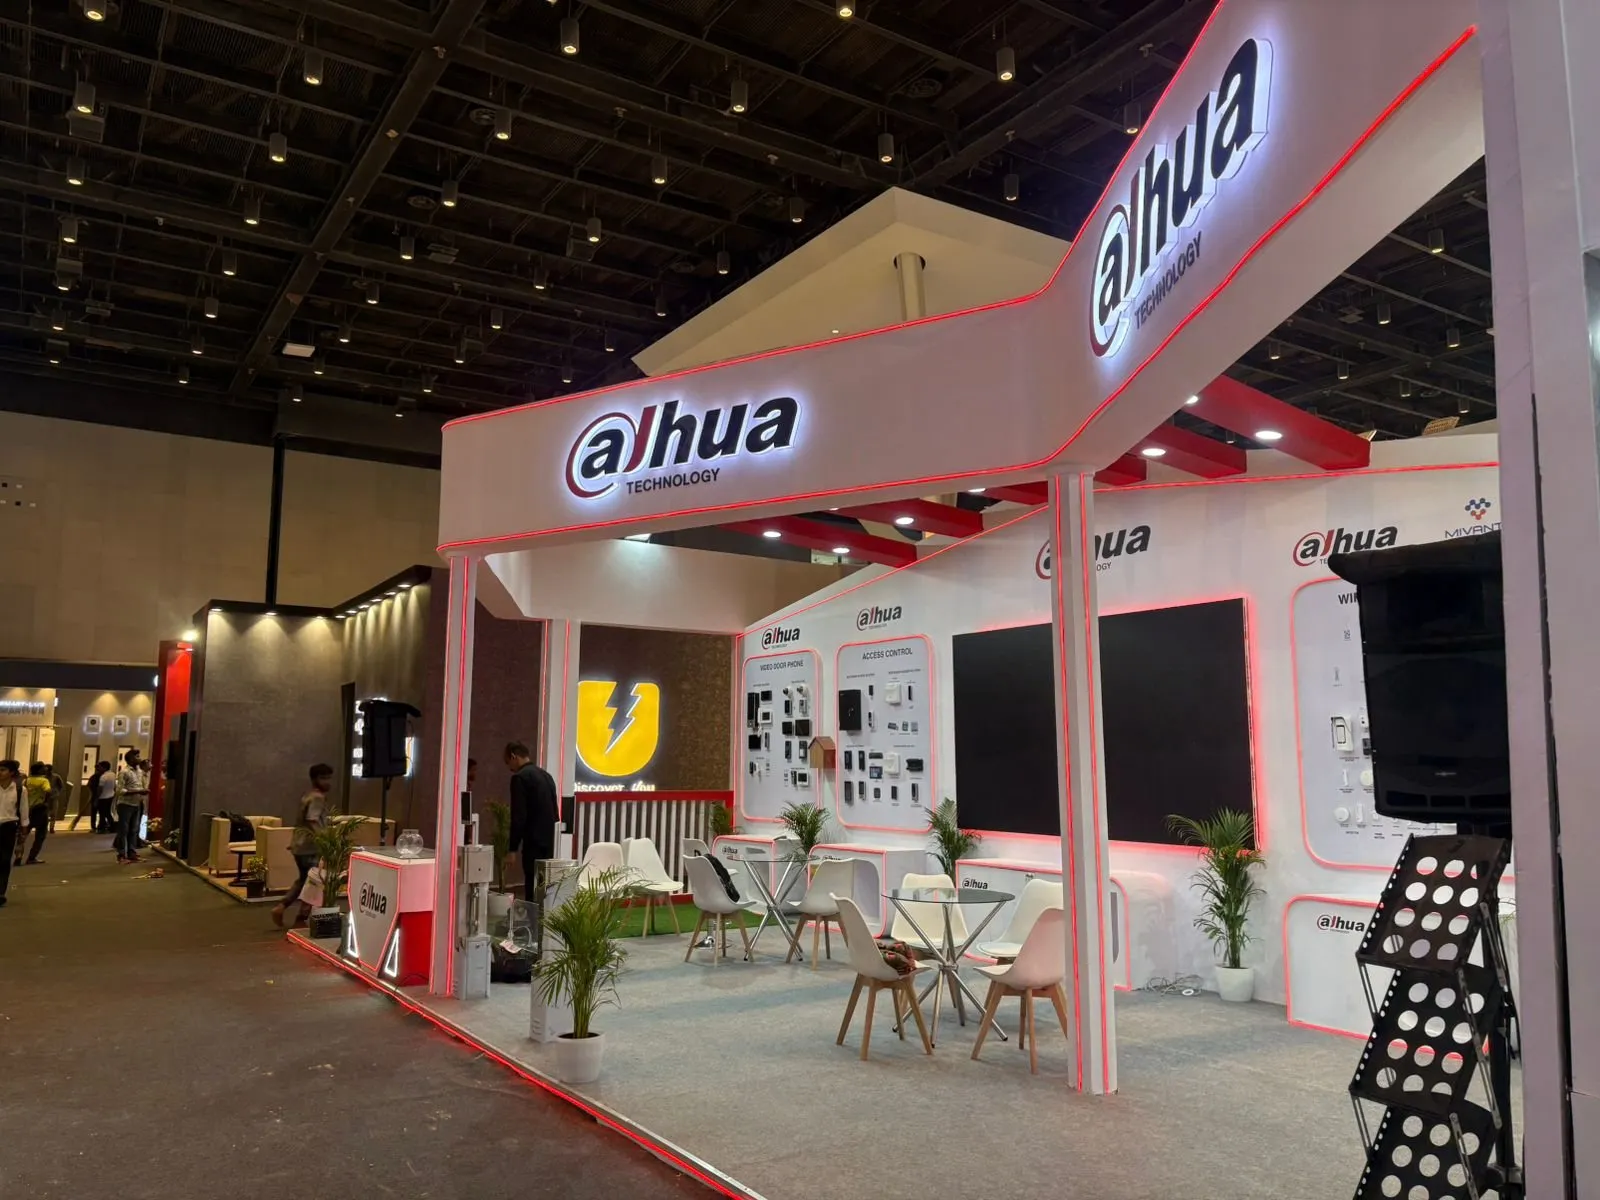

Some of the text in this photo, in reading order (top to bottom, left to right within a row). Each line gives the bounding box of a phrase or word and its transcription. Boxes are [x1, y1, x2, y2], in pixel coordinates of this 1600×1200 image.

[1134, 231, 1203, 330] TECHNOLOGY
[626, 467, 721, 494] TECHNOLOGY
[862, 647, 913, 660] ACCESS CONTROL
[773, 661, 787, 669] DOOR
[787, 659, 804, 668] PHONE
